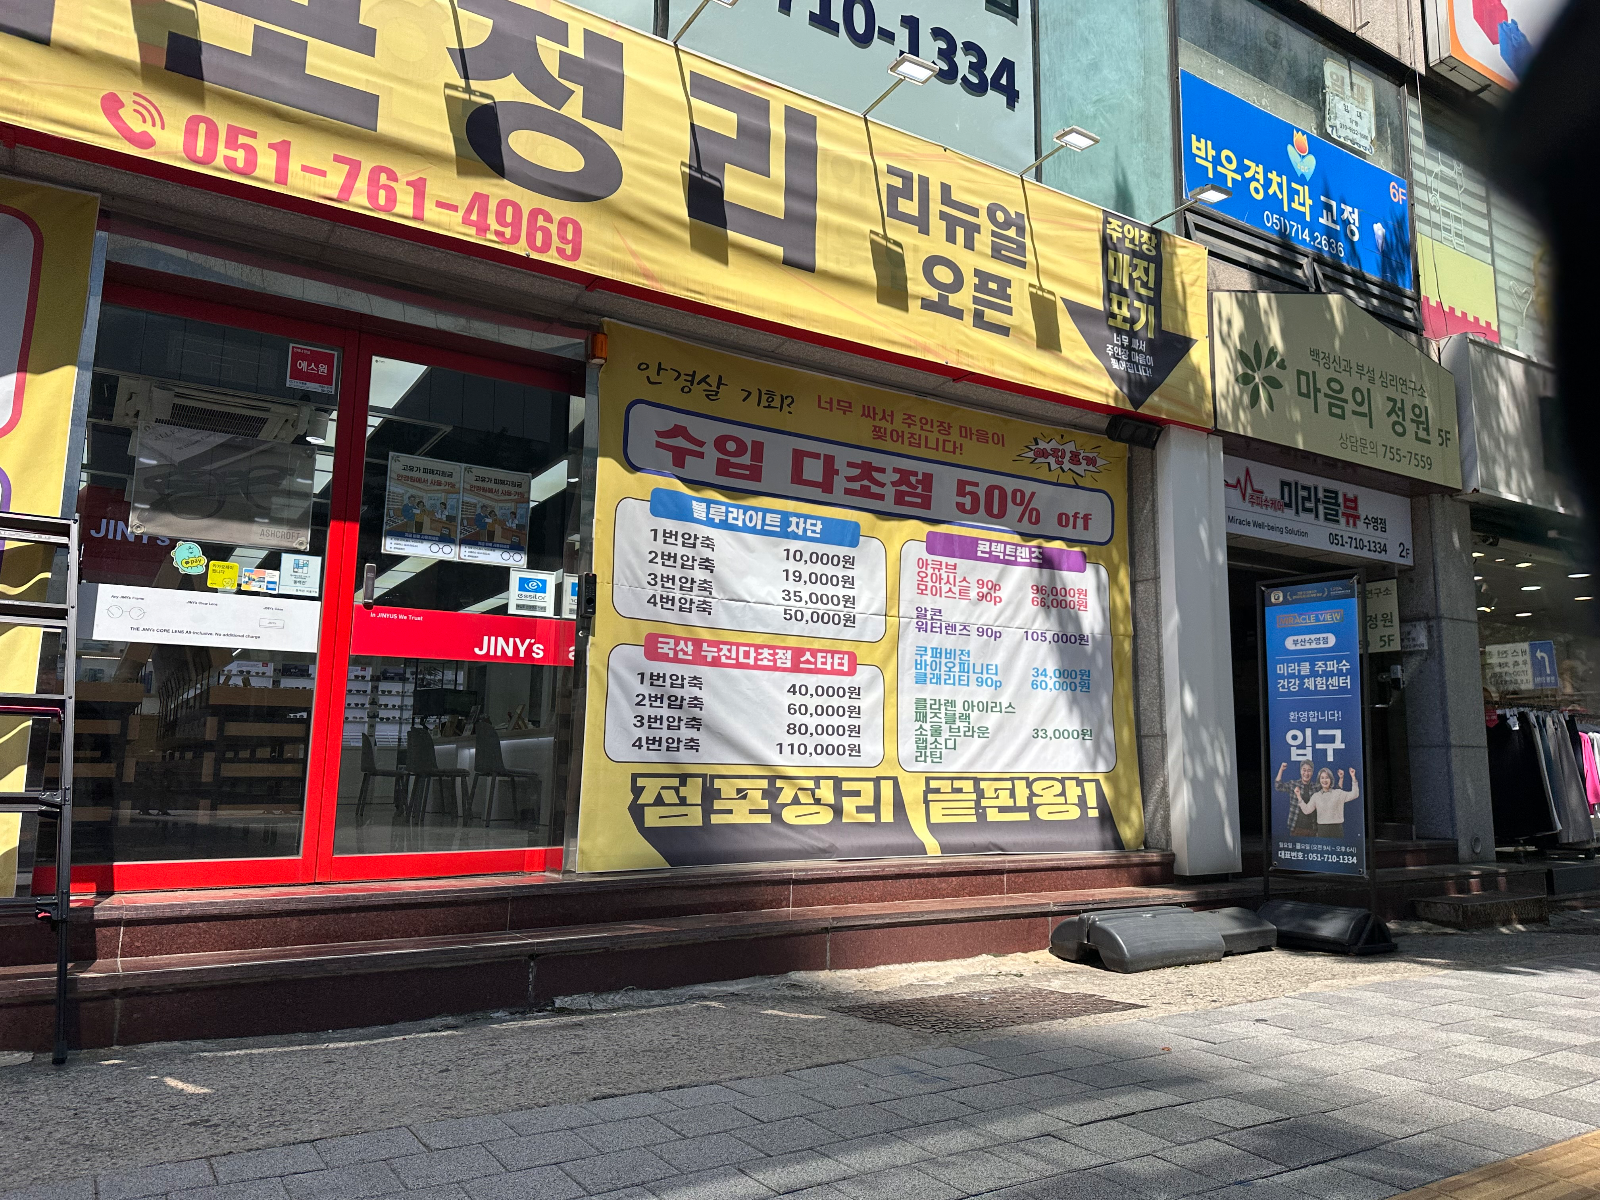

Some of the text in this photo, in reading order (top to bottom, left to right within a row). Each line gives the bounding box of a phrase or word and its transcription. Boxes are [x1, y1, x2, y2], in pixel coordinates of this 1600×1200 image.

[182, 114, 584, 263] 051-761-4969
[1191, 134, 1312, 222] 박우경치과
[1318, 195, 1361, 242] 교정
[1389, 181, 1406, 206] 6F
[885, 164, 1028, 270] 리뉴얼
[1106, 217, 1158, 256] 주인장
[1263, 210, 1345, 258] 051)714.2636
[1107, 250, 1157, 298] 마진
[920, 255, 1014, 337] 오픈
[1107, 298, 1156, 339] 포기
[1113, 332, 1146, 353] 너무 싸서
[1105, 343, 1155, 367] 주인장 마음이
[1110, 357, 1154, 377] 찢어집니다!
[297, 359, 328, 376] 에스원
[1309, 347, 1428, 399] 백정신과 부설 심리연구소
[637, 361, 795, 414] 안경살 기회?
[1296, 368, 1431, 445] 마음의 정원
[817, 394, 1006, 448] 너무 싸서 주인장 마음이
[871, 424, 964, 456] 찢어집니다!
[1437, 428, 1451, 449] 5F
[1339, 432, 1433, 471] 상담문의 755-7559
[654, 423, 1092, 531] 수입 다초점 50% off
[1248, 493, 1285, 513] 주파수케어
[1279, 478, 1361, 530] 미라클뷰
[692, 500, 823, 538] 블루라이트 차단
[1227, 514, 1309, 539] Miracle Well-being Solution
[1362, 516, 1387, 533] 수영점
[260, 528, 301, 540] ASHCROFT
[1328, 531, 1388, 555] 051-710-1334
[190, 557, 202, 565] pay
[649, 528, 856, 570] 1번압축 10,000원
[976, 540, 1043, 564] 콘텍트렌즈
[1398, 542, 1410, 559] 2F
[647, 550, 856, 590] 2번압축 19,000원
[917, 557, 958, 575] 아큐브
[517, 592, 547, 601] essilor
[646, 572, 856, 610] 3번압축 35,000원
[916, 570, 1088, 599] 오아시스 90p 96,000원
[916, 582, 1089, 612] 모이스트 90p 66,000원
[377, 612, 398, 620] JINYUS
[646, 594, 856, 628] 4번압축 50,000원
[915, 606, 943, 621] 알콘
[1280, 612, 1341, 625] MIRACLE VIEW
[1367, 611, 1394, 629] 정원
[915, 620, 1090, 646] 워터렌즈 90p 105,000원
[1292, 635, 1329, 647] 부산수영점
[1379, 634, 1395, 648] 5F
[474, 635, 544, 659] JINY's
[657, 637, 849, 671] 국산 누진다초점 스타터
[914, 645, 971, 662] 쿠퍼비전
[914, 659, 1091, 681] 바이오피니티 34,000원
[1276, 659, 1351, 676] 미라클 주파수
[636, 671, 862, 700] 1번압축 40,000원
[914, 673, 1091, 693] 클래리티 90p 60,000원
[1277, 675, 1351, 692] 건강 체험센터
[634, 693, 862, 719] 2번압축 60,000원
[913, 710, 971, 725] 째즈블랙
[914, 697, 1016, 714] 클라렌 아이리스
[1288, 710, 1342, 723] 환영합니다!
[632, 714, 862, 738] 3번압축 80,000원
[914, 724, 1094, 741] 소울 브라운 33,000원
[631, 736, 862, 758] 4번압축 110,000원
[914, 737, 957, 751] 랩소디
[1285, 728, 1346, 763] 입구
[914, 751, 944, 764] 라틴
[636, 777, 1099, 828] 점포정리 끝판왕!
[1278, 850, 1357, 864] 대표번호 051-710-1334
